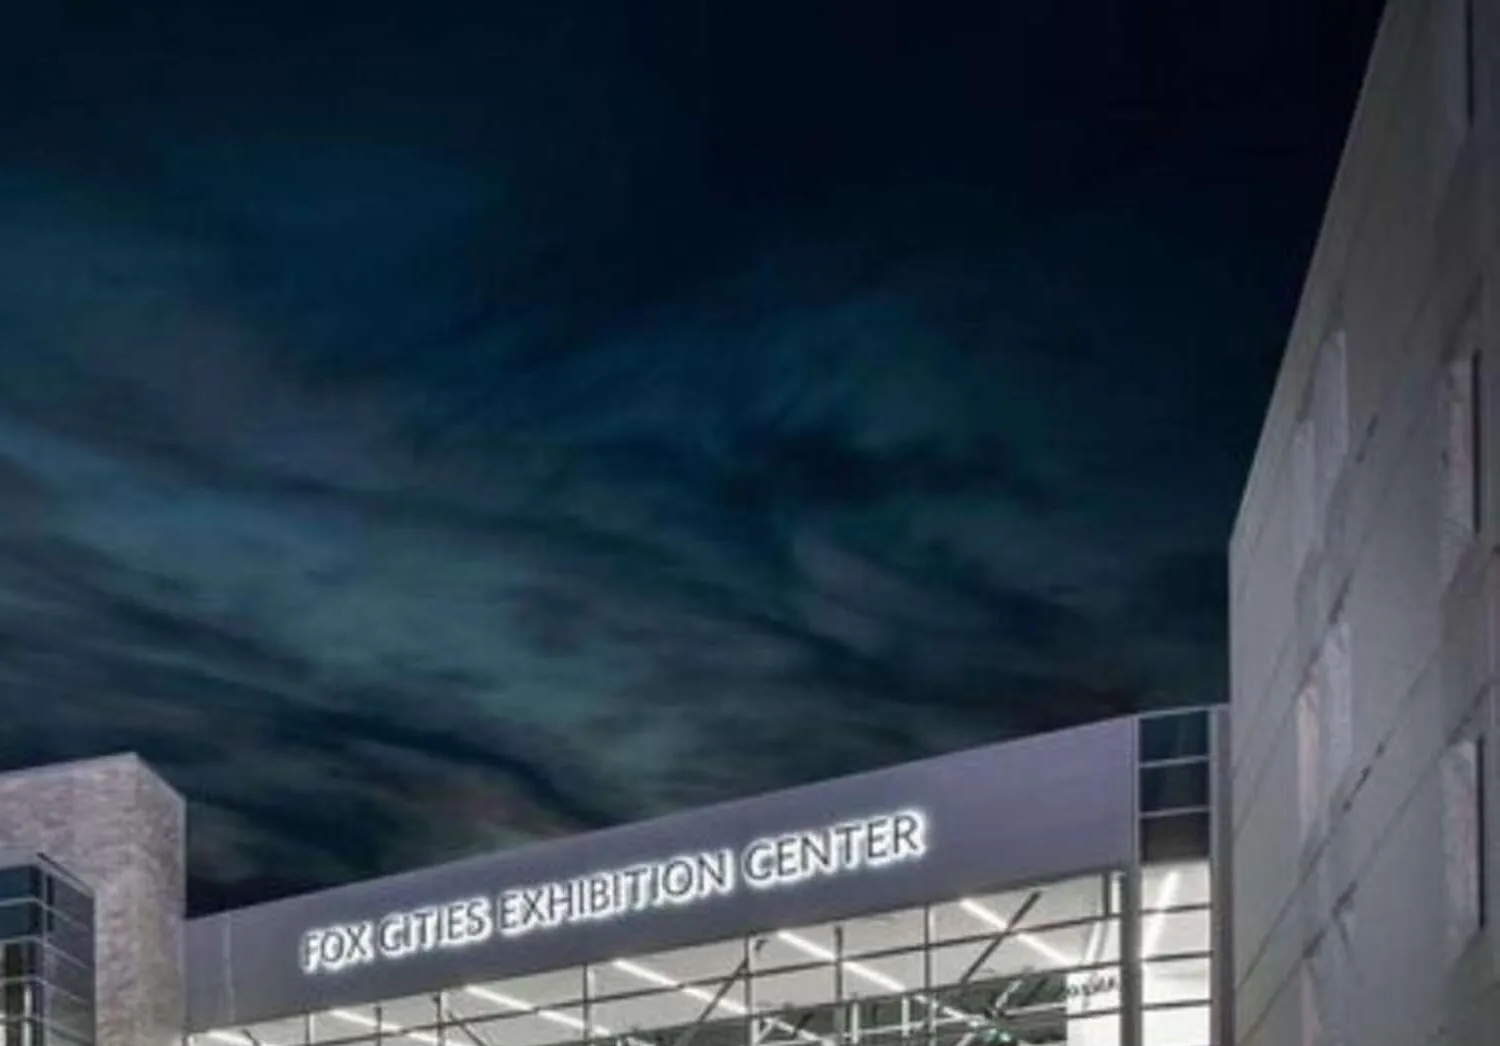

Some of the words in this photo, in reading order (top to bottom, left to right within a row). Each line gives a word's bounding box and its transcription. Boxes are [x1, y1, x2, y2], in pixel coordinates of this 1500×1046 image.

[303, 923, 372, 971] FOX
[378, 899, 489, 954] CITIES
[499, 853, 729, 935] EXHIBITION
[743, 812, 923, 885] CENTER
